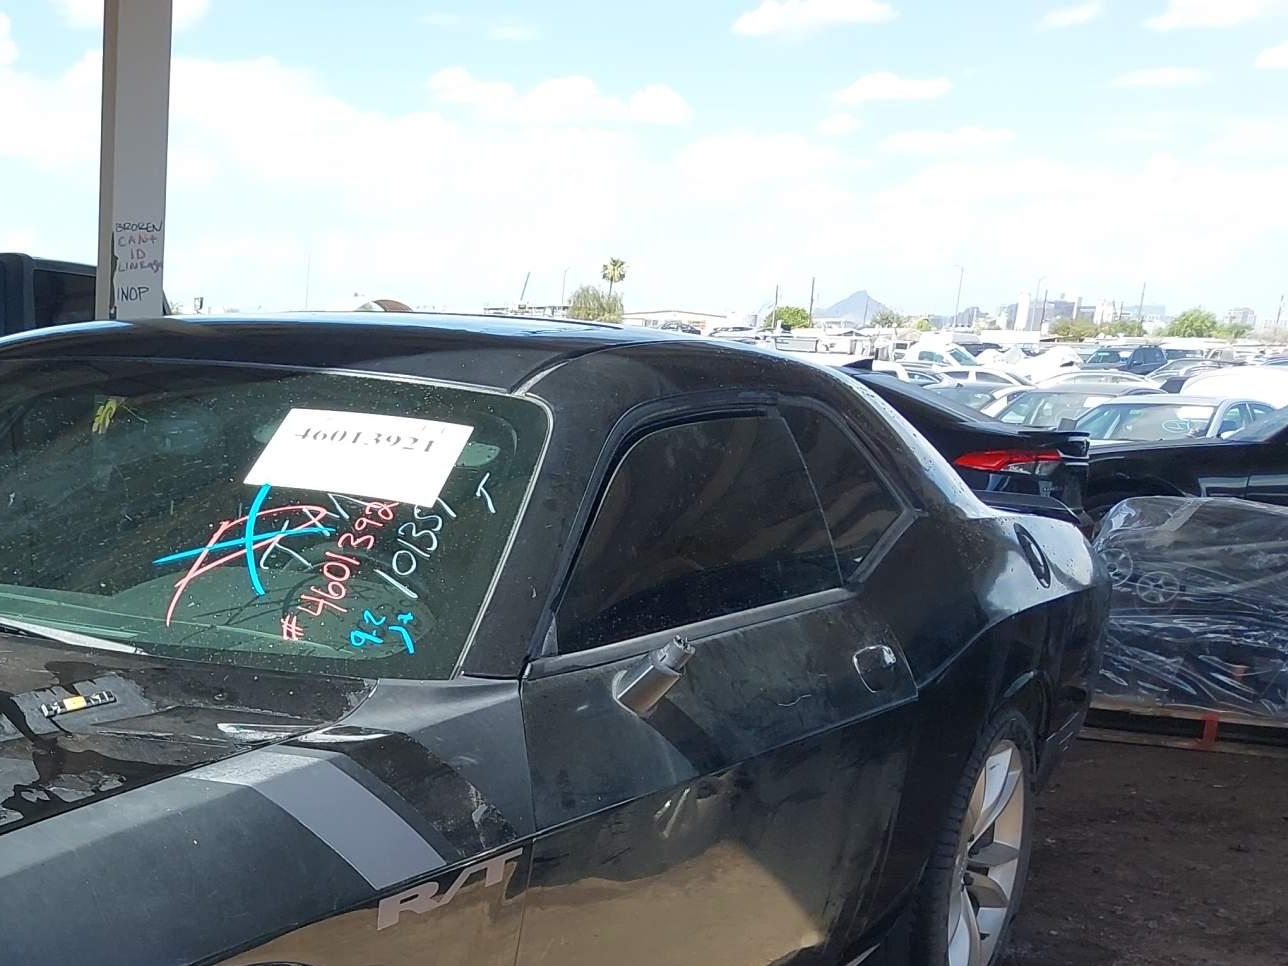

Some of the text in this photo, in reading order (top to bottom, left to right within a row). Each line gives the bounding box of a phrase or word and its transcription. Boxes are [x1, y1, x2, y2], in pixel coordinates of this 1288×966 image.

[115, 221, 163, 233] BROKEN
[130, 248, 146, 260] ID
[117, 286, 150, 302] INOP
[295, 427, 435, 453] 46013921
[376, 847, 523, 931] R/T
